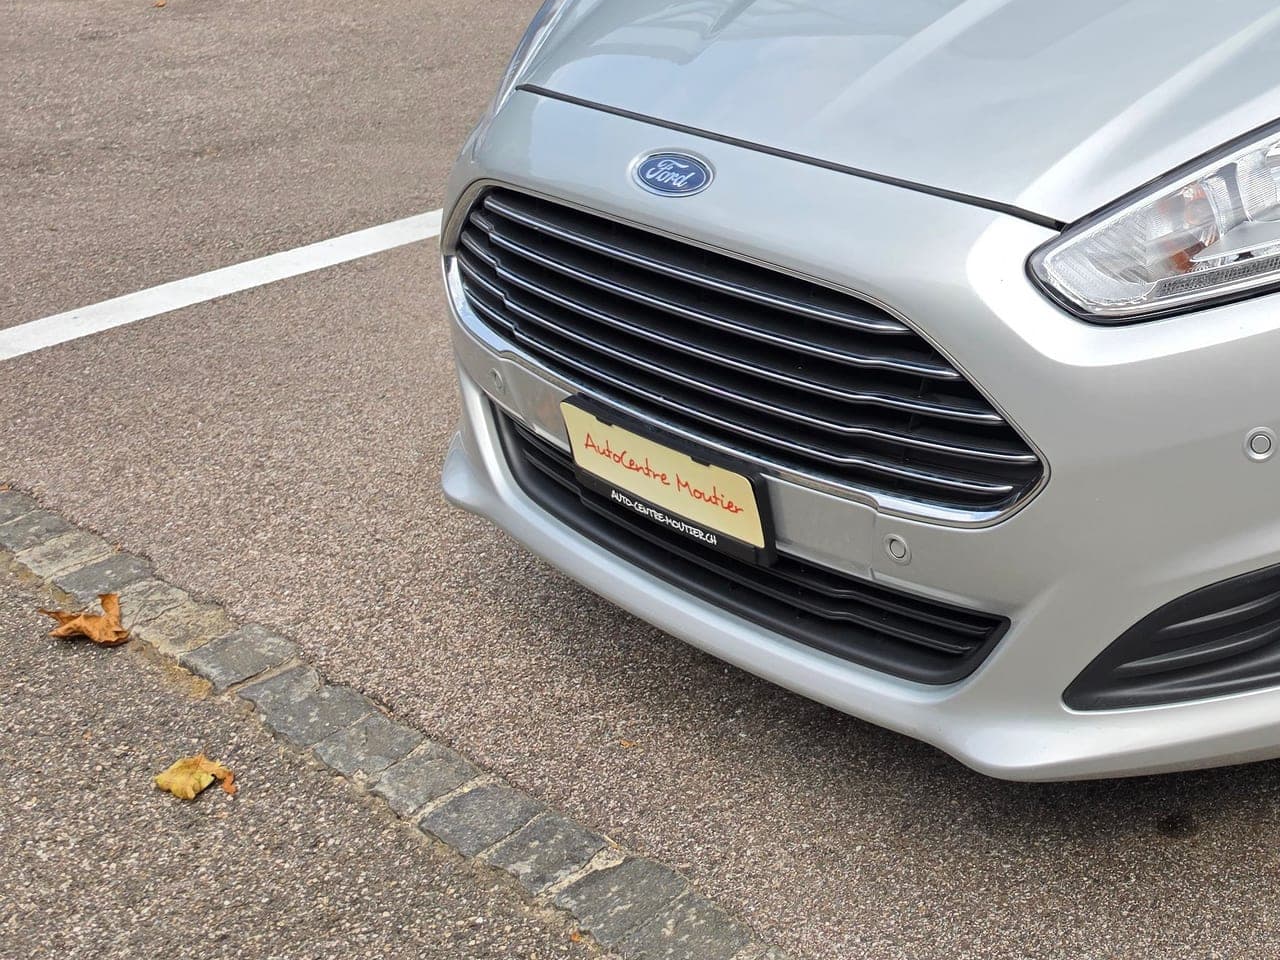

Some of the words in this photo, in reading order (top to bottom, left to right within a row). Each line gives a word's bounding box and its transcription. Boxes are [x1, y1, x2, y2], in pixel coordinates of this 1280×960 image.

[645, 159, 696, 188] Ford
[584, 432, 670, 486] AutoCentre
[676, 473, 744, 515] Moutier
